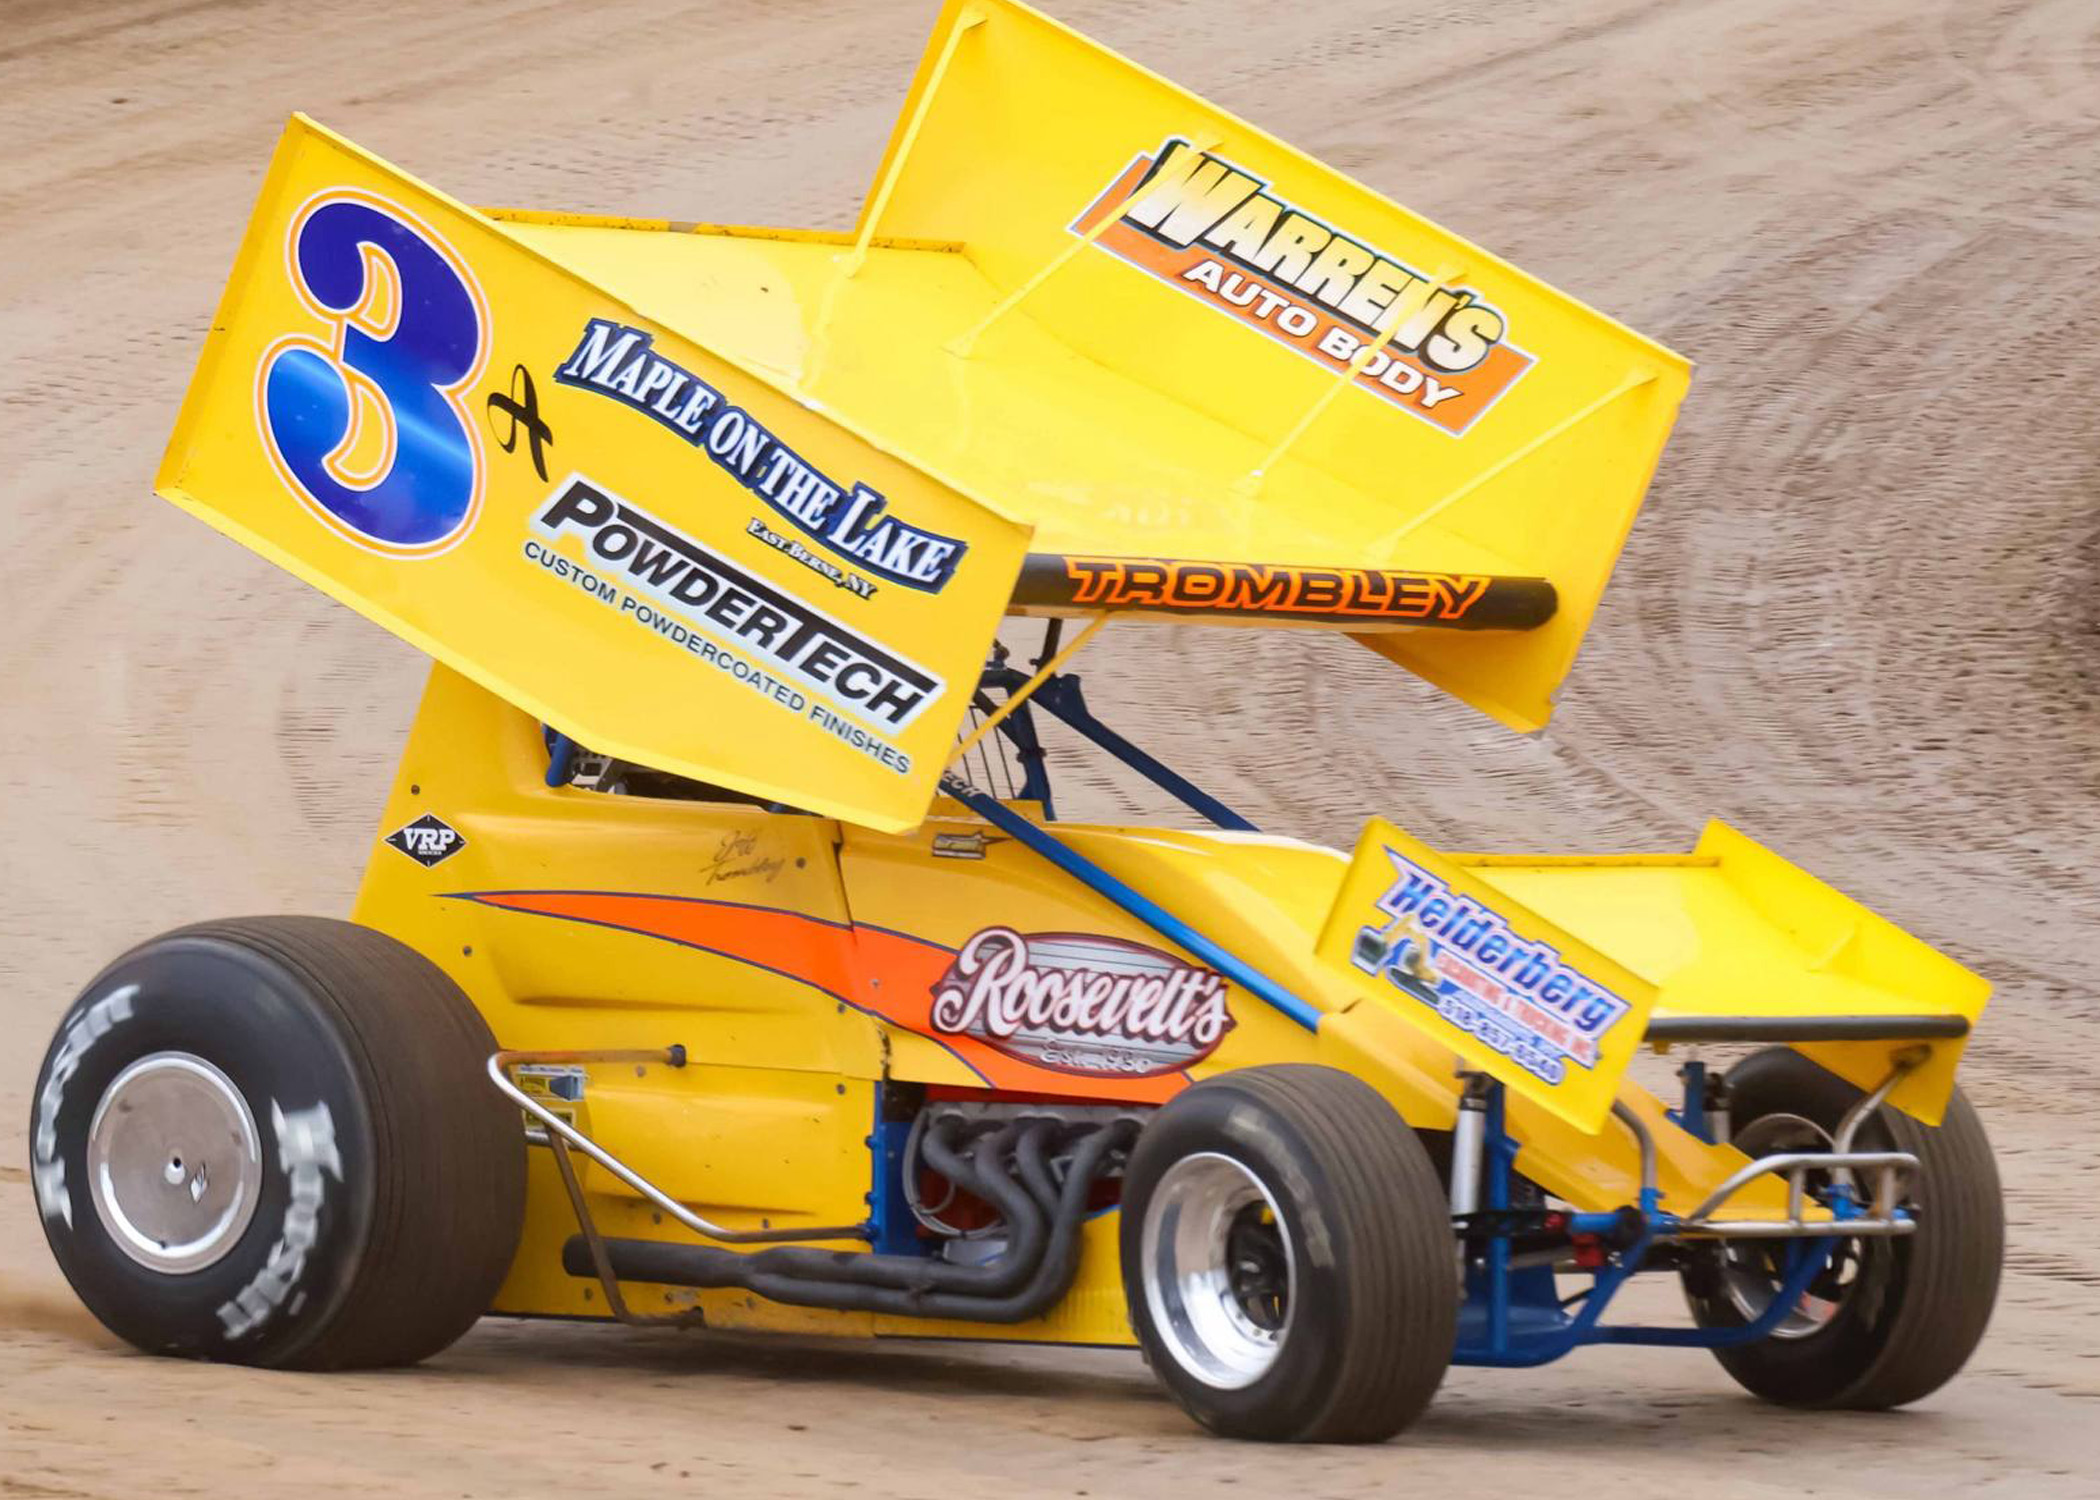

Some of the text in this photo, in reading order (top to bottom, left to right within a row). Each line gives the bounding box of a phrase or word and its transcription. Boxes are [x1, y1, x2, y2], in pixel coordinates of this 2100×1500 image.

[1122, 140, 1503, 373] WARREN'S
[1183, 259, 1464, 409] AUTO BODY
[254, 186, 493, 560] 3
[564, 322, 955, 582] MAPLE ON THE LAKE
[524, 540, 911, 776] CUSTOM POWDERCOATED FINISHES
[541, 480, 944, 724] POWDERTECH
[1063, 557, 1493, 620] TROMBLEY
[403, 828, 456, 851] VRP
[933, 928, 1230, 1044] Roosevelt's
[1389, 872, 1616, 1033] Helderberg
